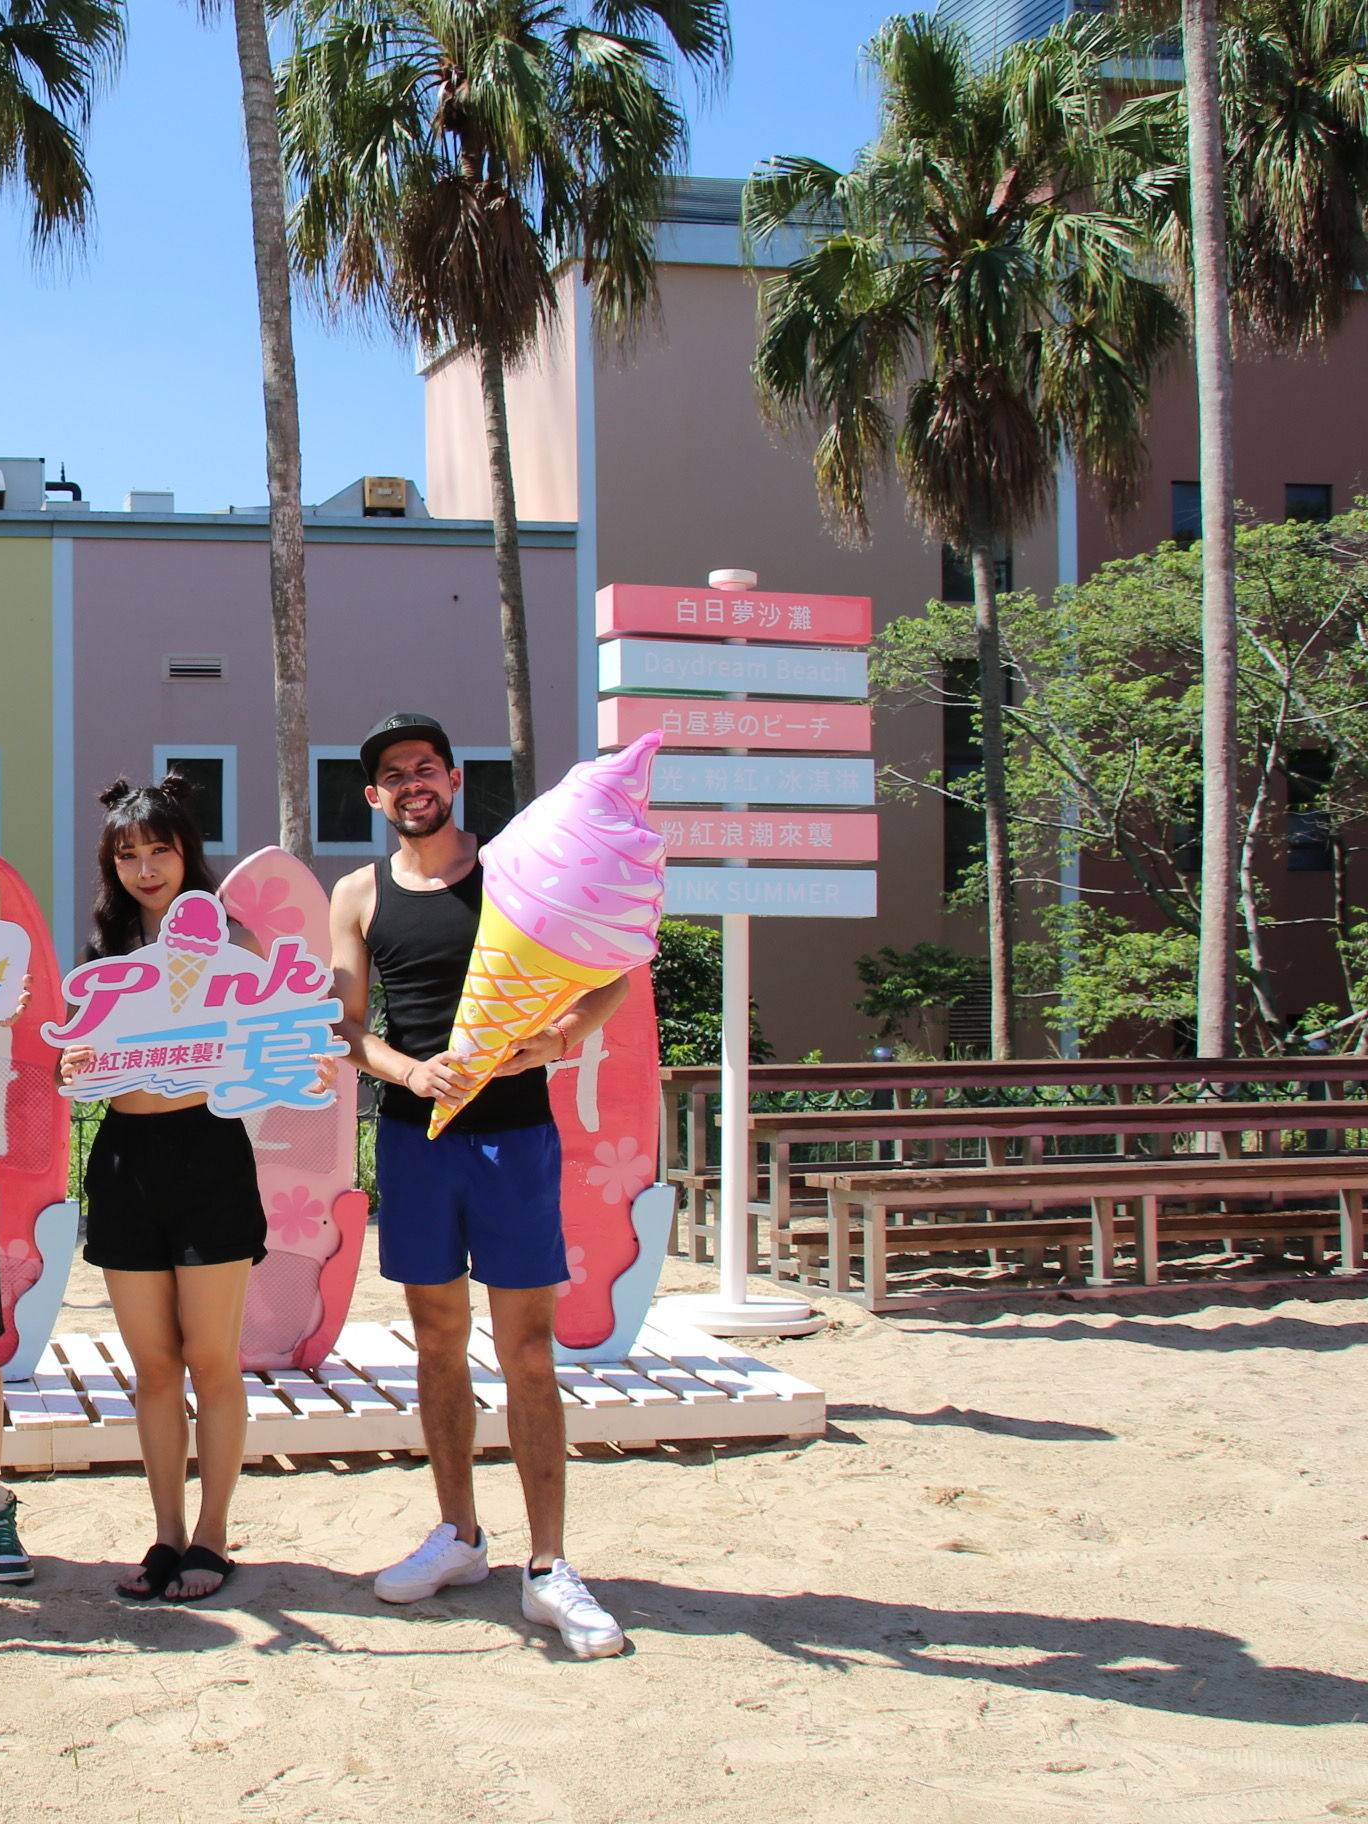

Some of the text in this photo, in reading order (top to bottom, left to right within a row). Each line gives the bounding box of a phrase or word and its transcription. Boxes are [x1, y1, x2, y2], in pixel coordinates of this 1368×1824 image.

[676, 597, 813, 631] 白日夢沙灘
[644, 651, 847, 682] Daydream Beach
[662, 711, 831, 739] 白昼夢のビーチ
[660, 820, 833, 848] 粉紅浪潮來襲
[727, 880, 840, 905] SUMMER
